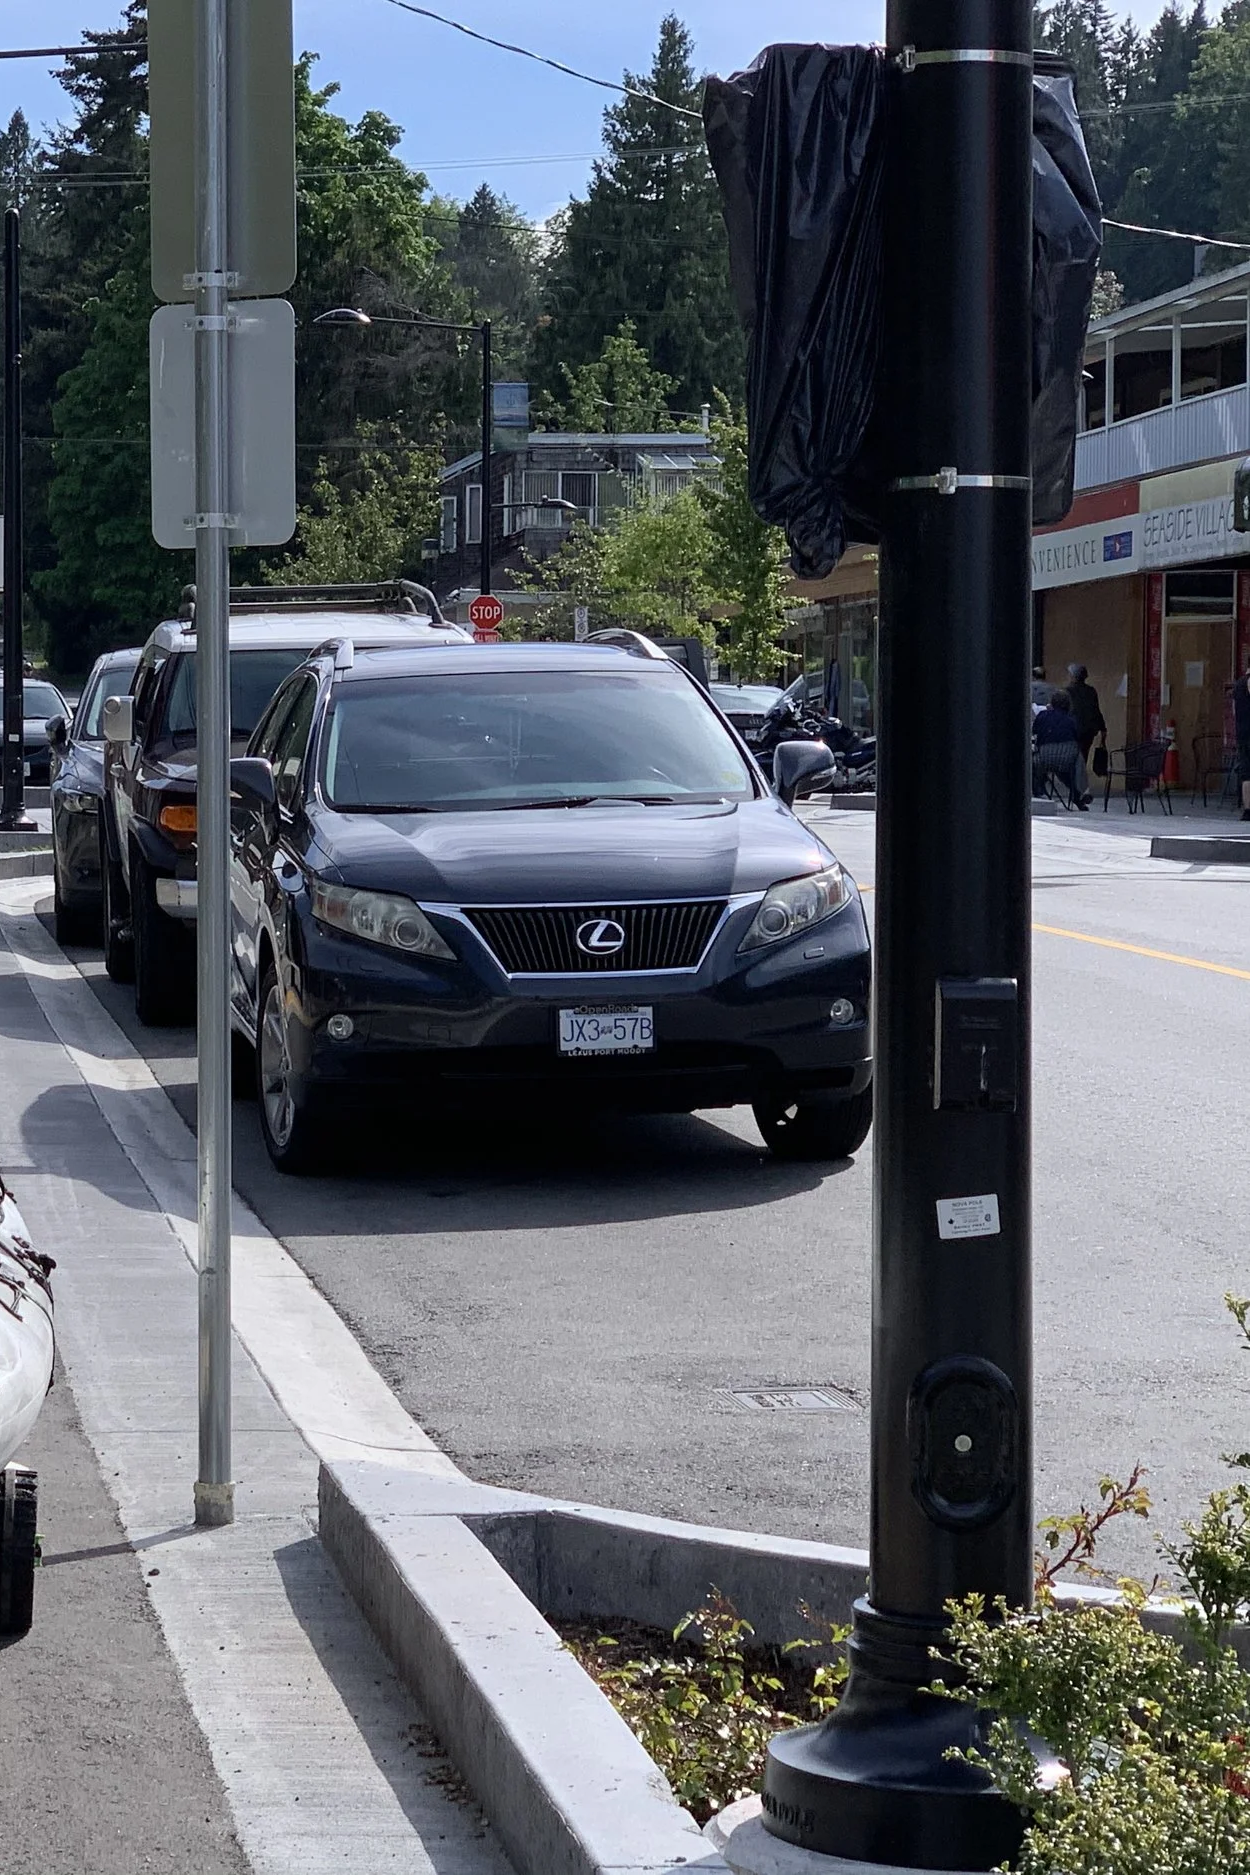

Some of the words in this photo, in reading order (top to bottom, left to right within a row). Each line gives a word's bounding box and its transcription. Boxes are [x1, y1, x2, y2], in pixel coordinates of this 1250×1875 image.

[1144, 508, 1193, 548] SEASIDE
[1195, 499, 1235, 538] VILLAG
[1032, 540, 1096, 574] NVENIENCE
[472, 605, 501, 620] STOP
[562, 1018, 600, 1042] JX3
[613, 1017, 653, 1041] 57B
[568, 1049, 593, 1057] LEXUS
